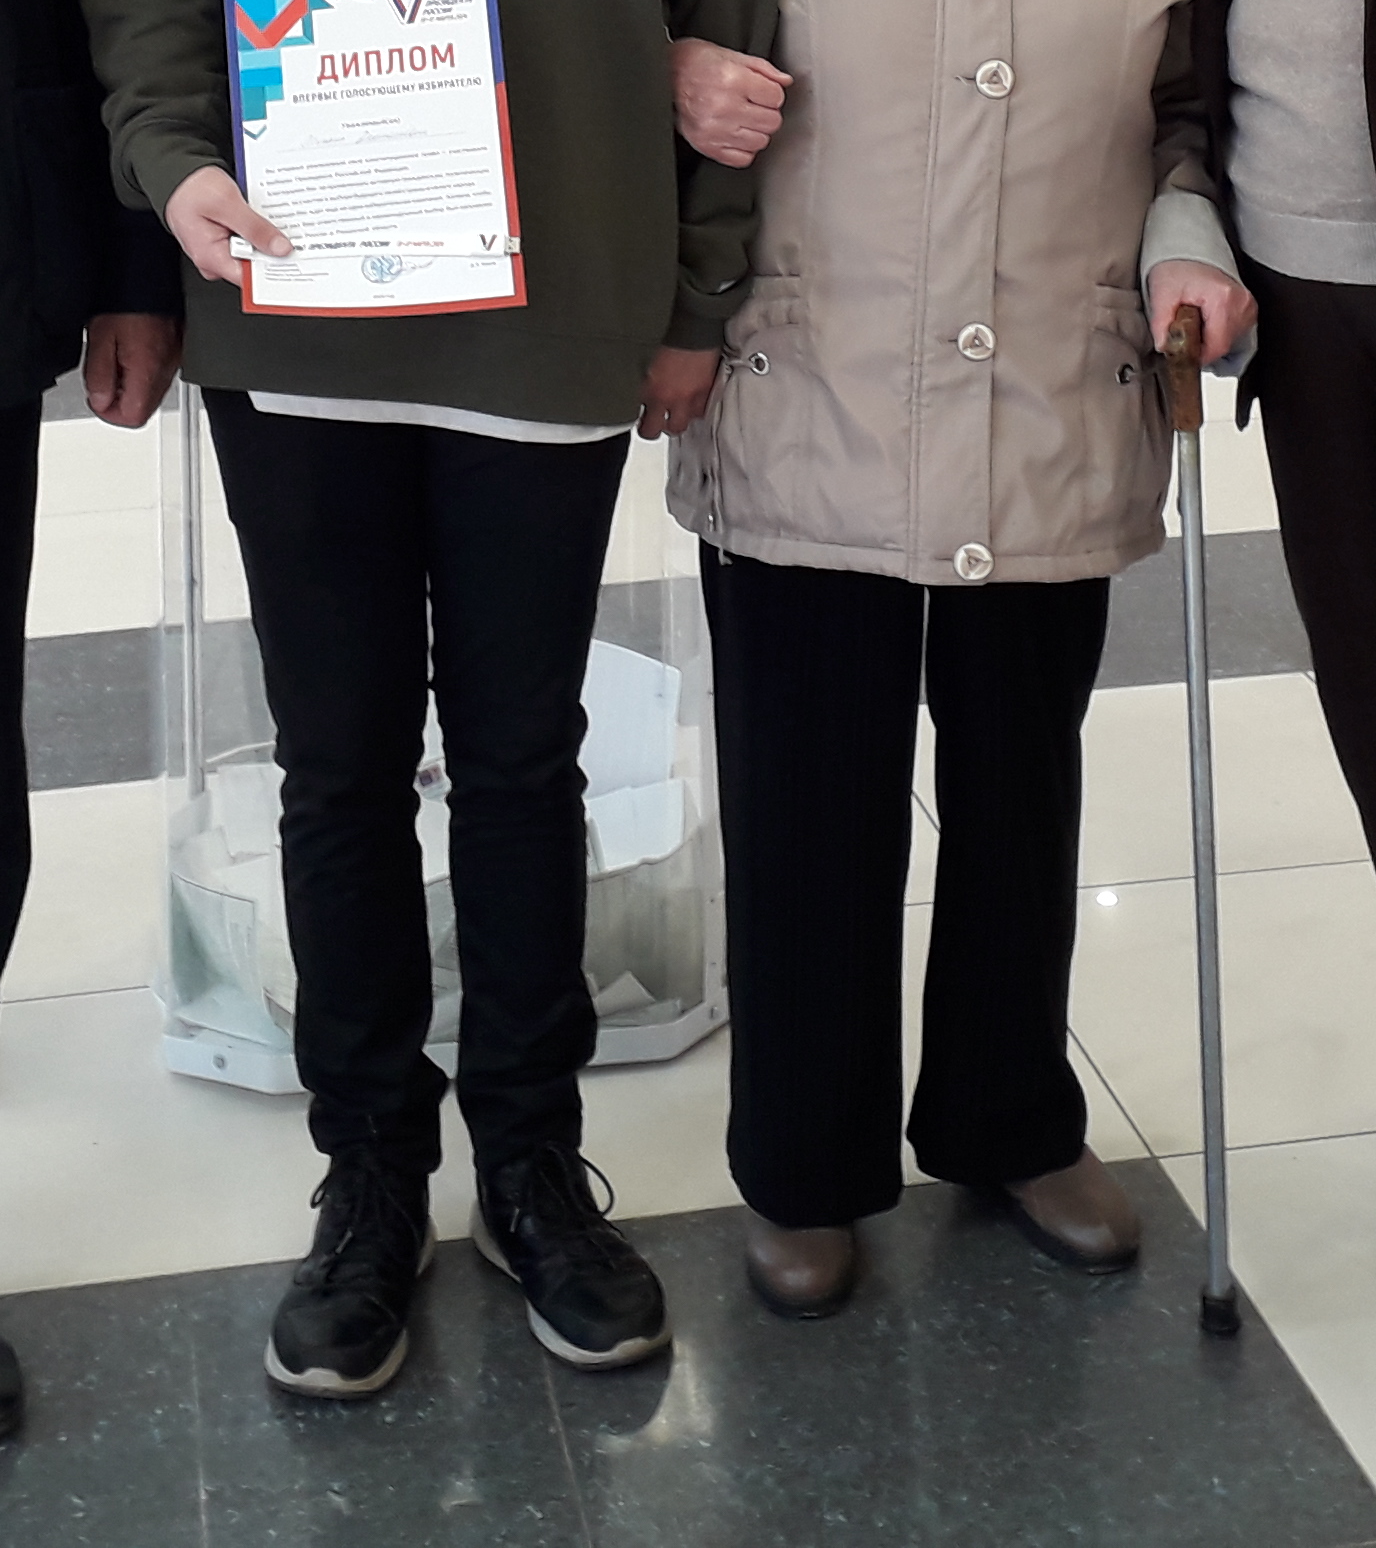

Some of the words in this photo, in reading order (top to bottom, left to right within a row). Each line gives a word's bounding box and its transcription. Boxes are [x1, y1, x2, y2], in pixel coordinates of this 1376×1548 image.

[317, 42, 455, 85] ДИПЛОМ
[292, 90, 337, 104] ВПЕРВЫЕ
[340, 83, 415, 99] ГОЛОСУЮЩЕМУ
[418, 77, 482, 92] ИЗБИРАТЕЛЮ
